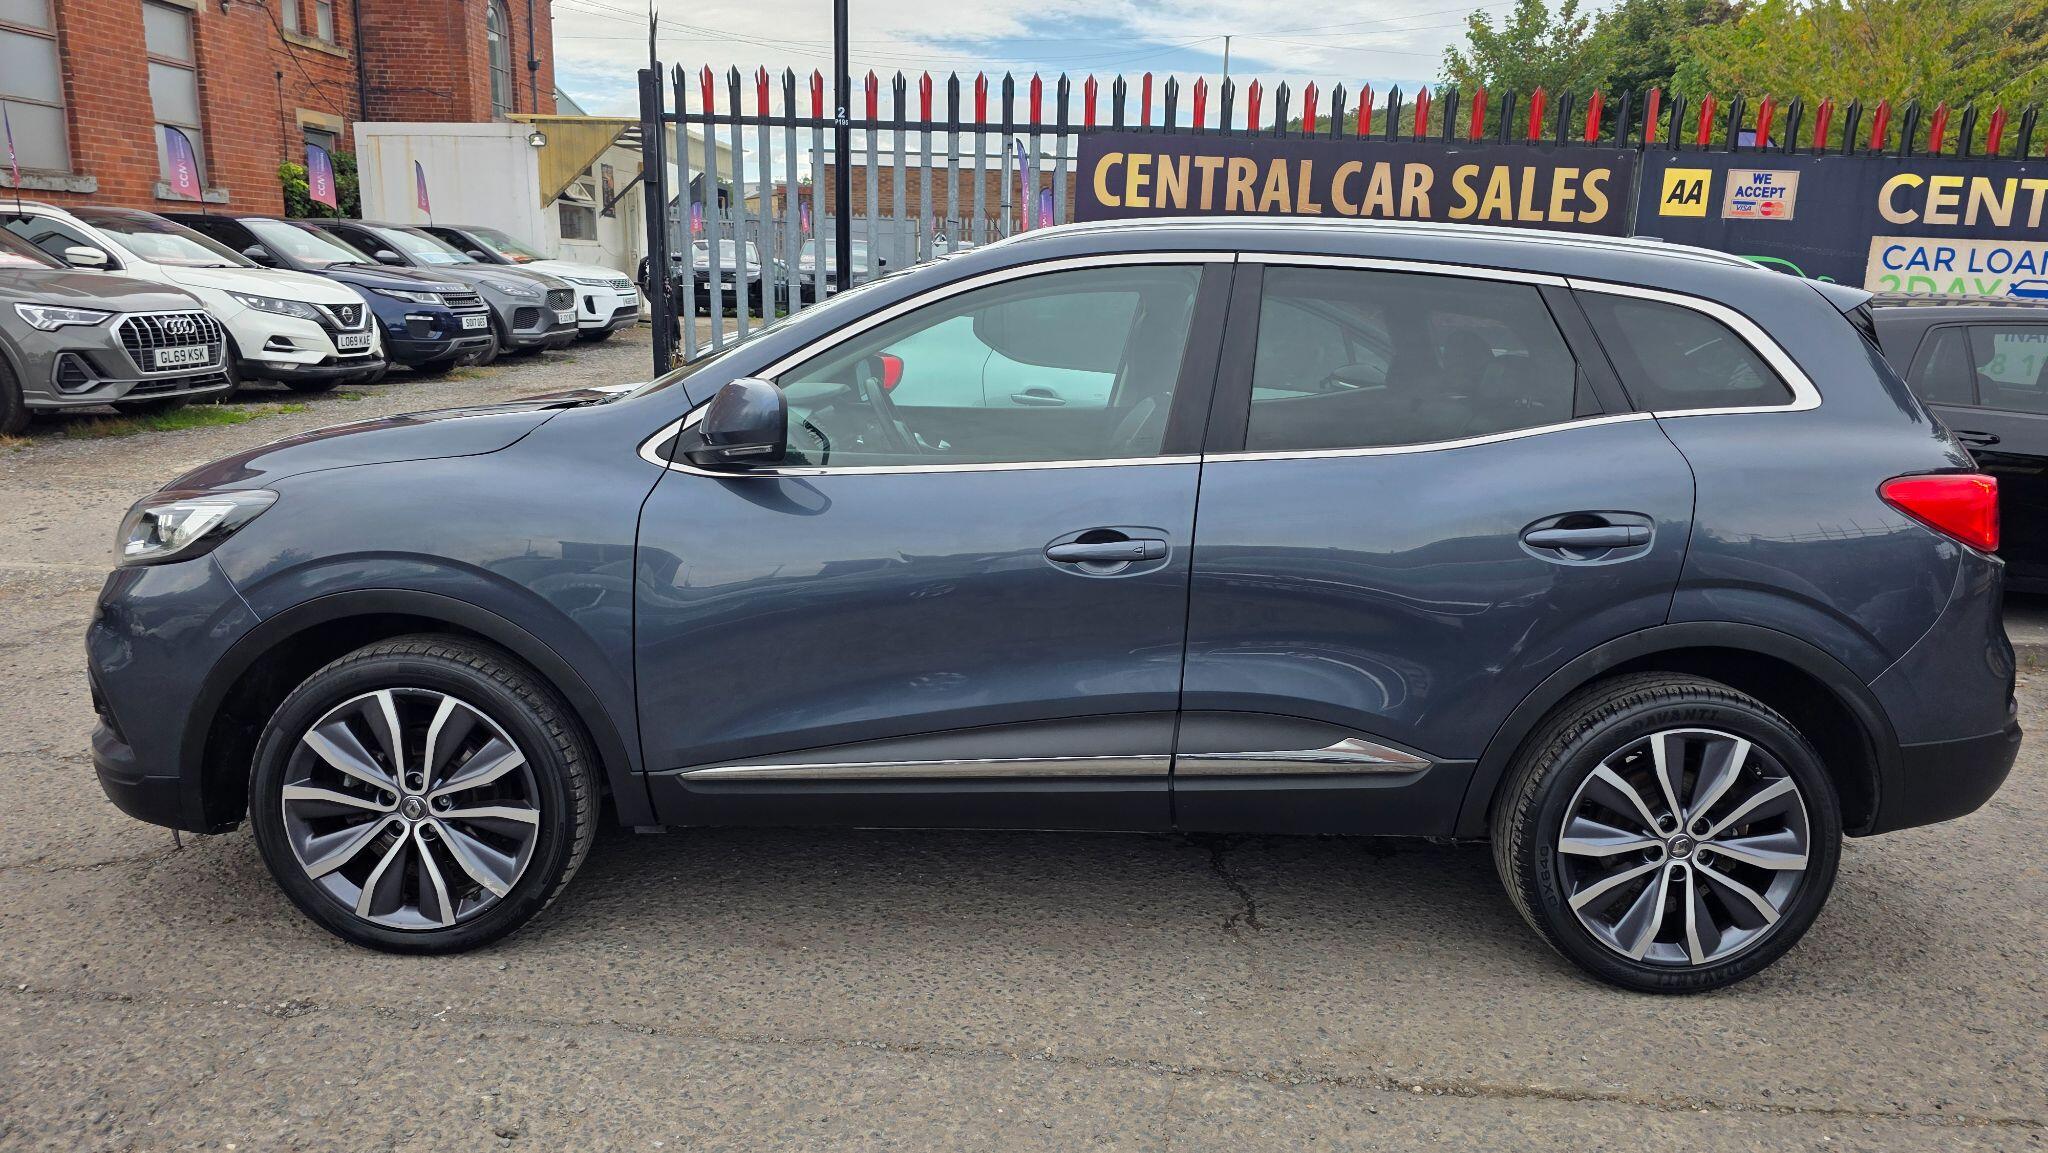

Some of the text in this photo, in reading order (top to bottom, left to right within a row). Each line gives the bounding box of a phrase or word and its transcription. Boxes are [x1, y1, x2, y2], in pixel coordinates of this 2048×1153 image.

[837, 106, 846, 118] 2
[1752, 172, 1773, 185] WE
[1093, 152, 1322, 214] CENTRAL
[1331, 160, 1434, 218] CAR
[1448, 164, 1611, 223] SALES
[1666, 179, 1704, 205] AA
[1734, 185, 1786, 199] ACCEPT
[1735, 204, 1753, 212] VISA
[1882, 244, 1956, 273] CAR
[160, 347, 205, 364] GL69 KSK
